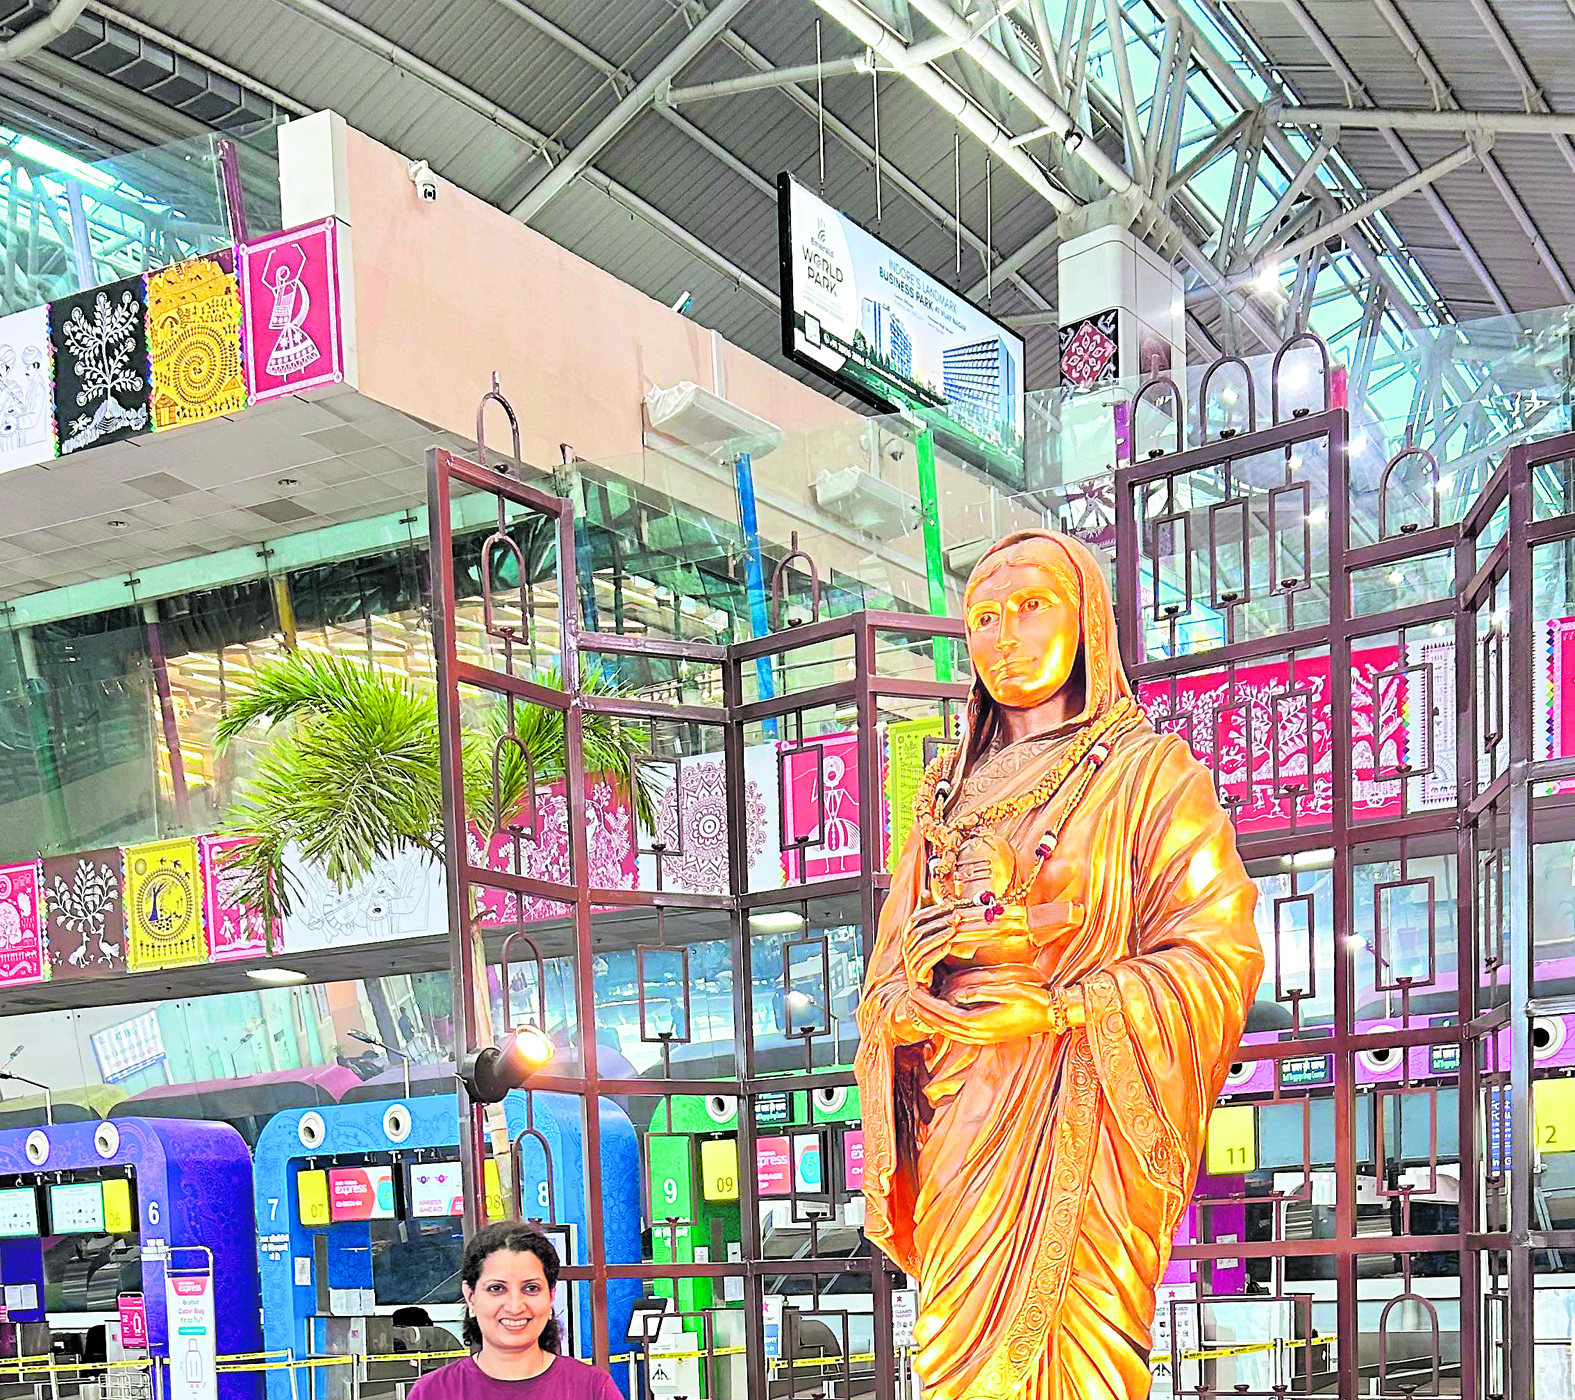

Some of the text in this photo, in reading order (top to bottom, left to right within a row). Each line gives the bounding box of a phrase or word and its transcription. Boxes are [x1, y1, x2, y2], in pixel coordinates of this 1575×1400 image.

[802, 244, 843, 283] WORLD
[807, 265, 838, 298] PARK
[879, 265, 915, 299] BUSINESS
[915, 290, 934, 313] PARK
[922, 281, 958, 315] LANDMARK
[1225, 1146, 1247, 1166] 11
[334, 1184, 368, 1197] express
[537, 1181, 550, 1208] 8
[662, 1177, 679, 1204] 9
[715, 1176, 734, 1194] 09
[148, 1200, 161, 1226] 6
[267, 1198, 280, 1221] 7
[310, 1203, 325, 1219] 07
[485, 1194, 502, 1211] 08
[108, 1211, 122, 1227] 06
